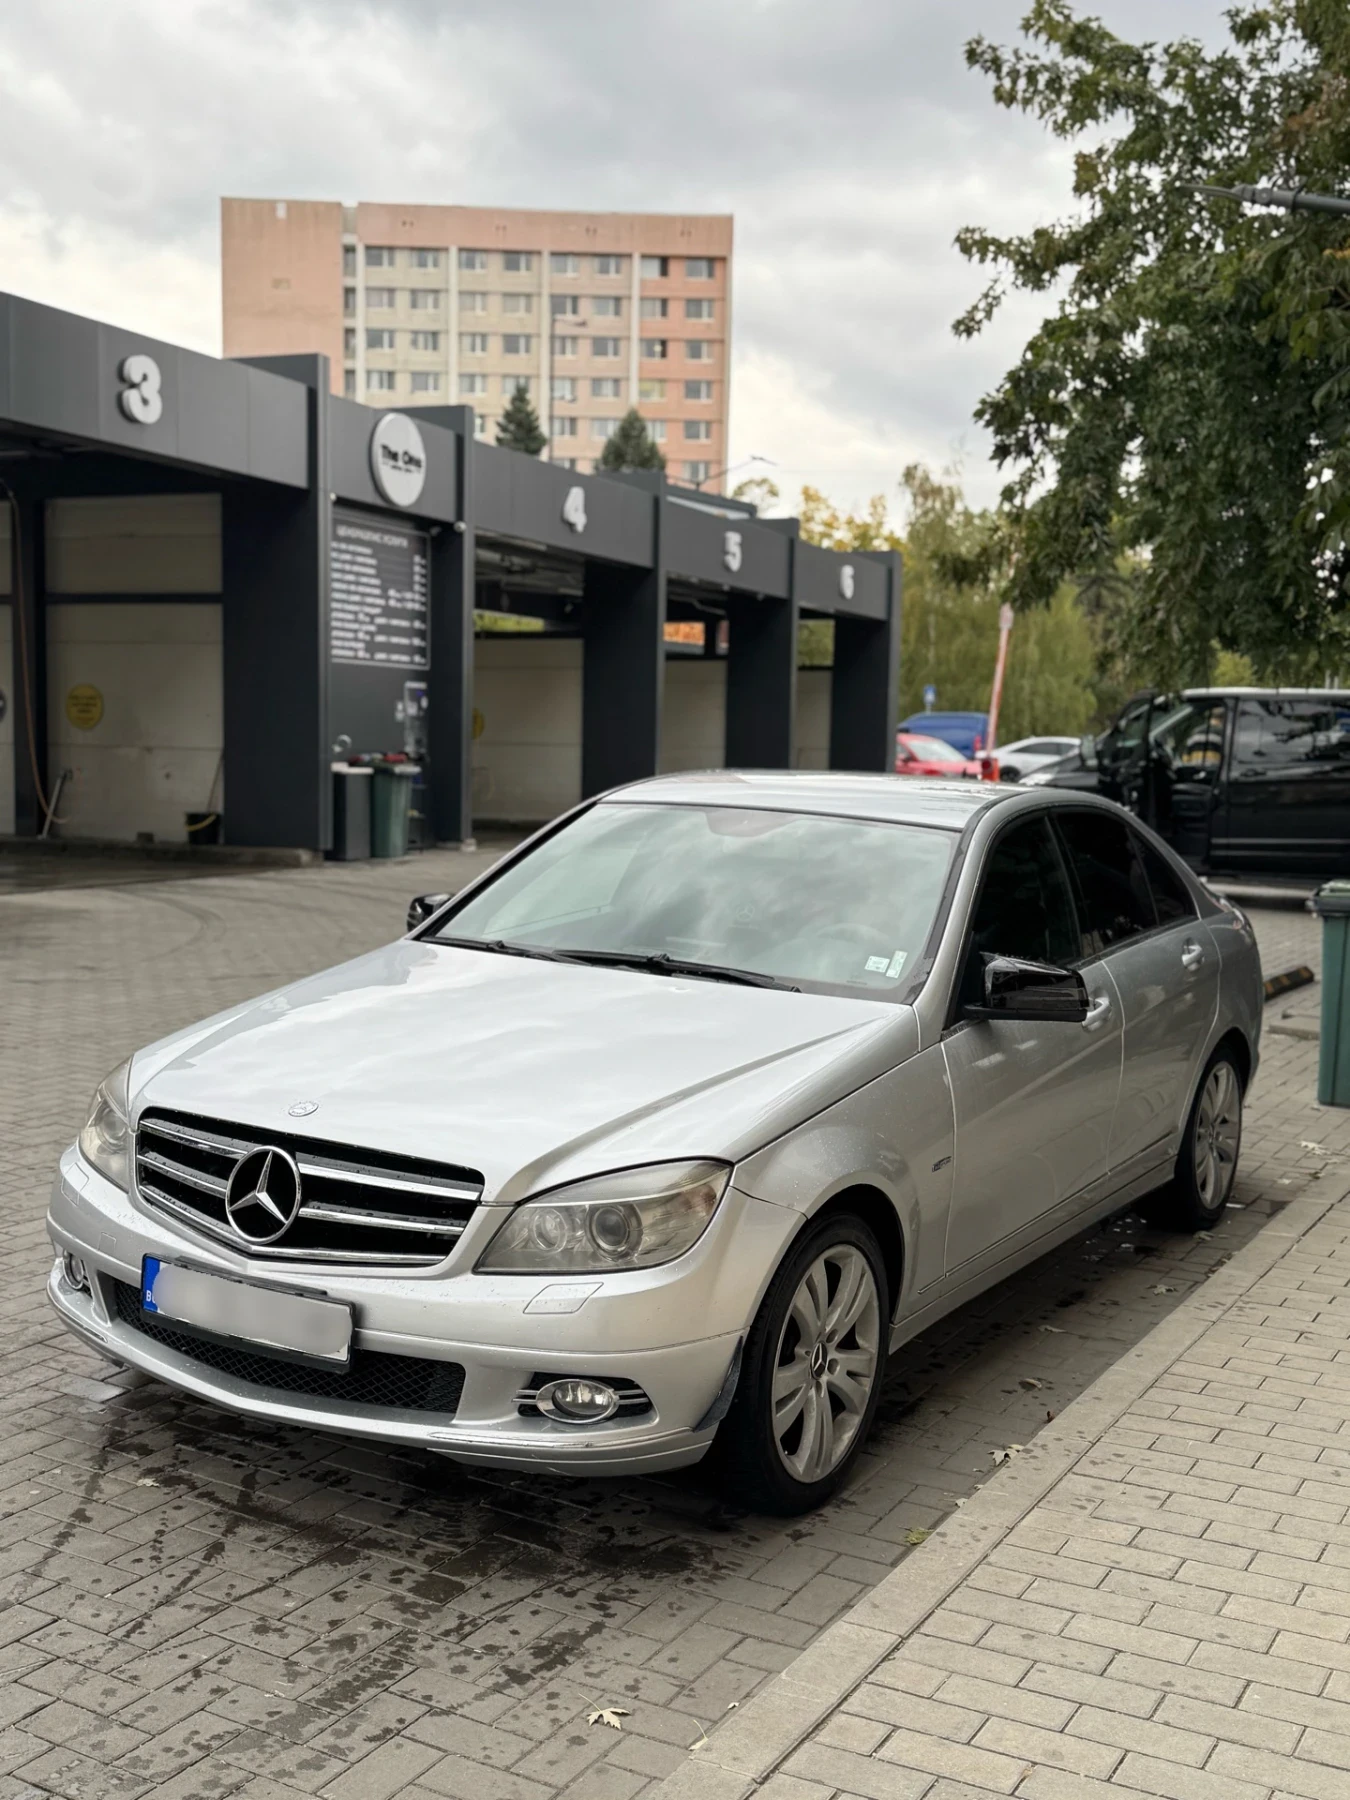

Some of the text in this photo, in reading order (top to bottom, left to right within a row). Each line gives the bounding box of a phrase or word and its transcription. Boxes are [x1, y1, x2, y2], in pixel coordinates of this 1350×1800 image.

[122, 354, 163, 424] 3
[381, 443, 399, 463] The
[563, 486, 588, 533] 4
[724, 531, 743, 572] 5
[840, 564, 855, 600] 6
